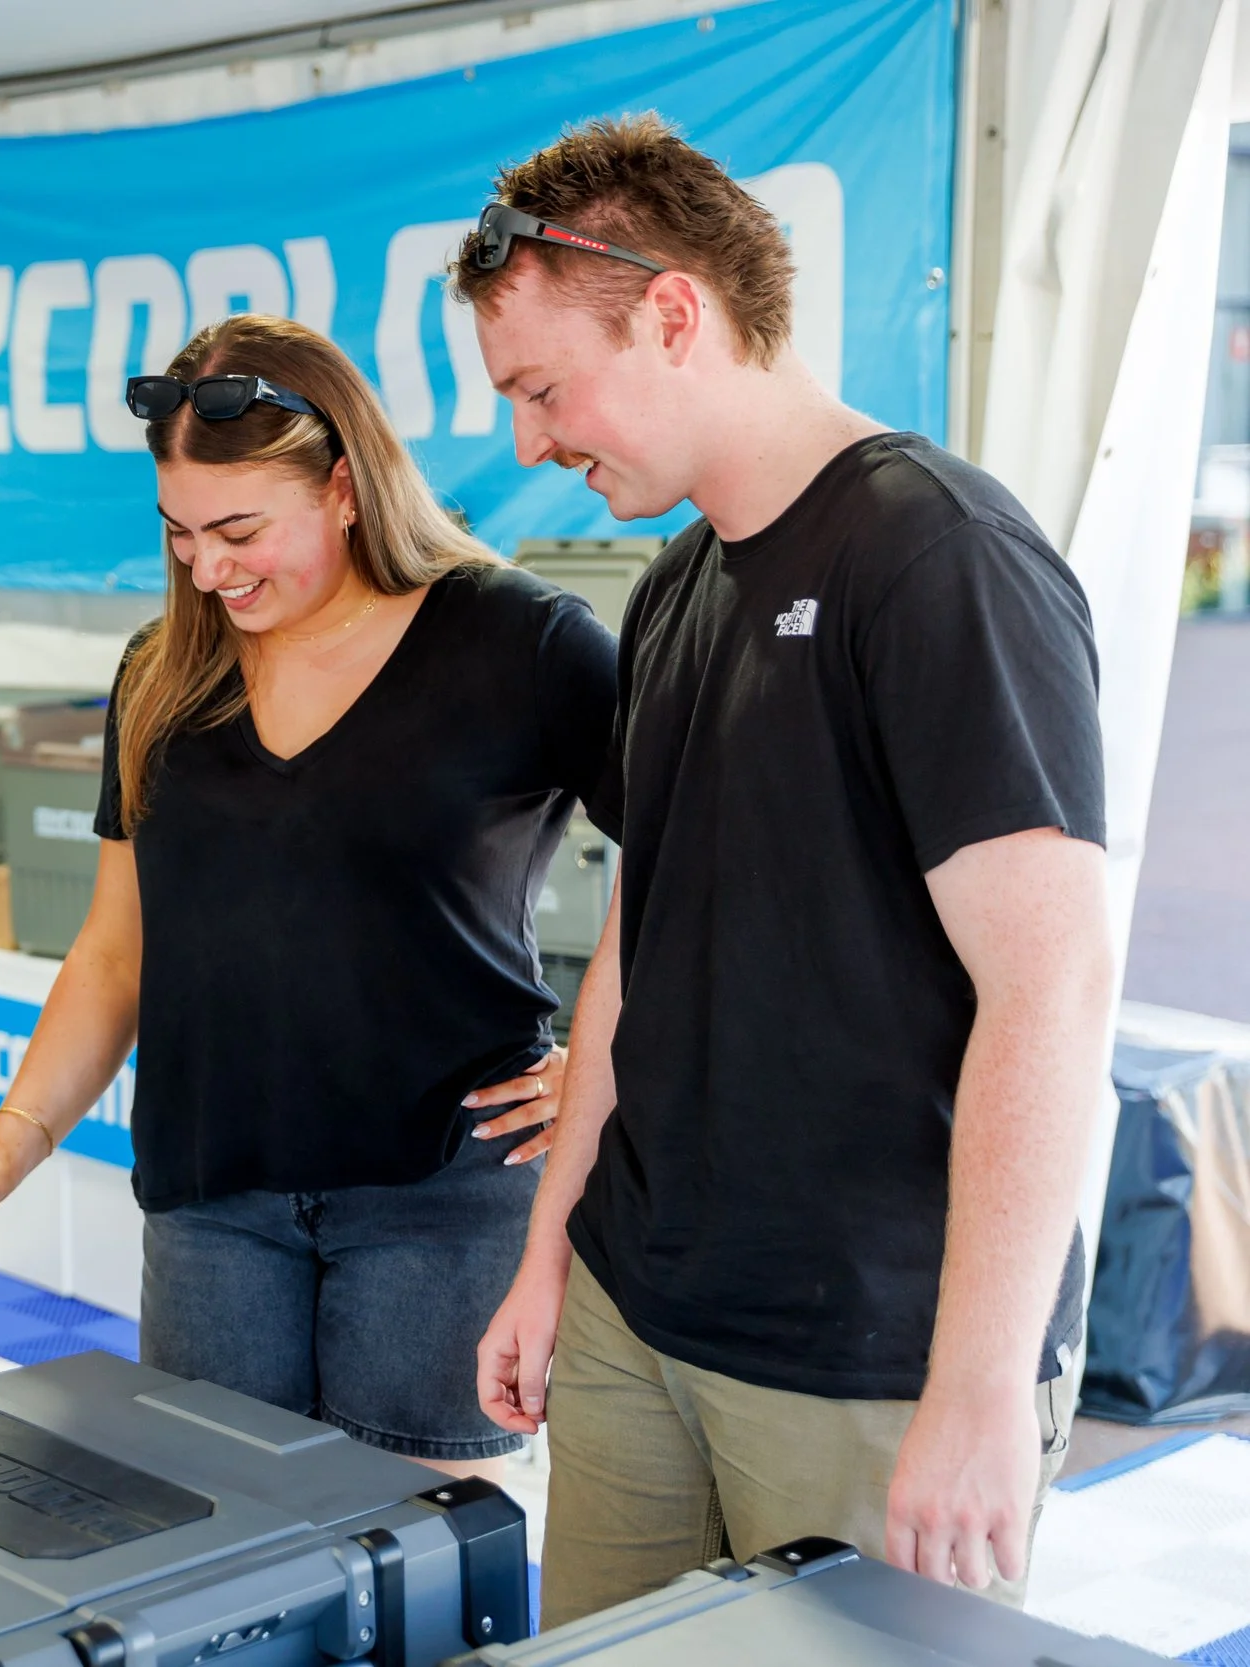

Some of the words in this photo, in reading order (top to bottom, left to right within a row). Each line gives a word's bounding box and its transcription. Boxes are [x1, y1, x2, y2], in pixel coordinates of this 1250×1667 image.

[792, 599, 808, 613] THE
[774, 611, 804, 626] NORTH
[776, 622, 800, 636] FACE
